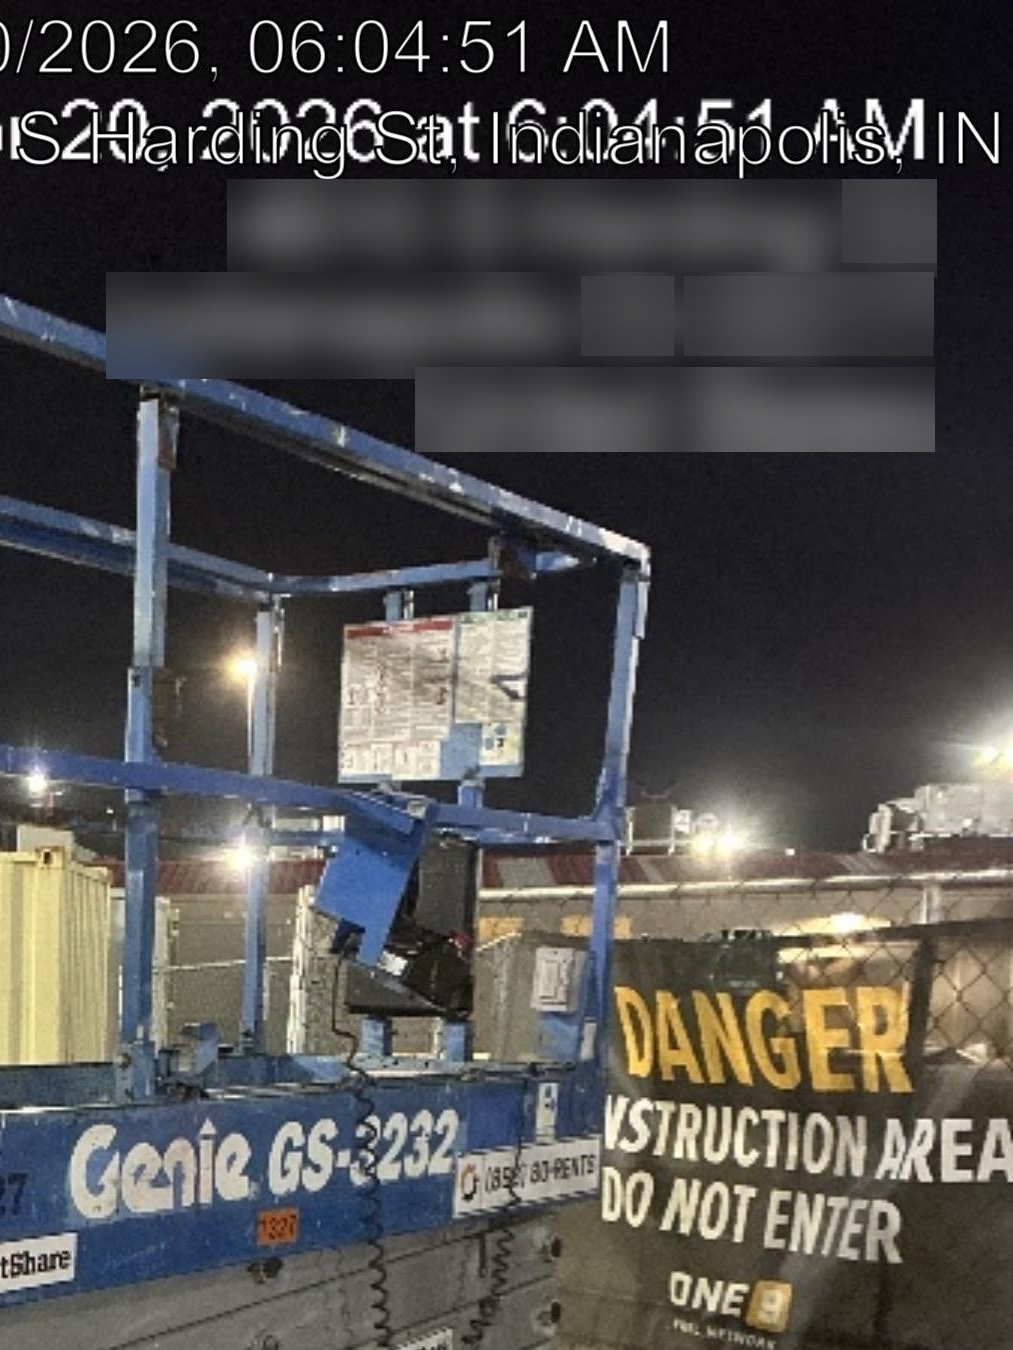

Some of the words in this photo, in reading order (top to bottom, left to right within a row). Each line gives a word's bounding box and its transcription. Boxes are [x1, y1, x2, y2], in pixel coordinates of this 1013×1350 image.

[614, 985, 914, 1093] DANGER
[69, 1118, 251, 1220] Genie
[268, 1108, 460, 1197] GS-3232
[601, 1167, 654, 1229] DO
[660, 1178, 756, 1243] NOT
[763, 1190, 903, 1264] ENTER
[669, 1270, 750, 1318] ONE
